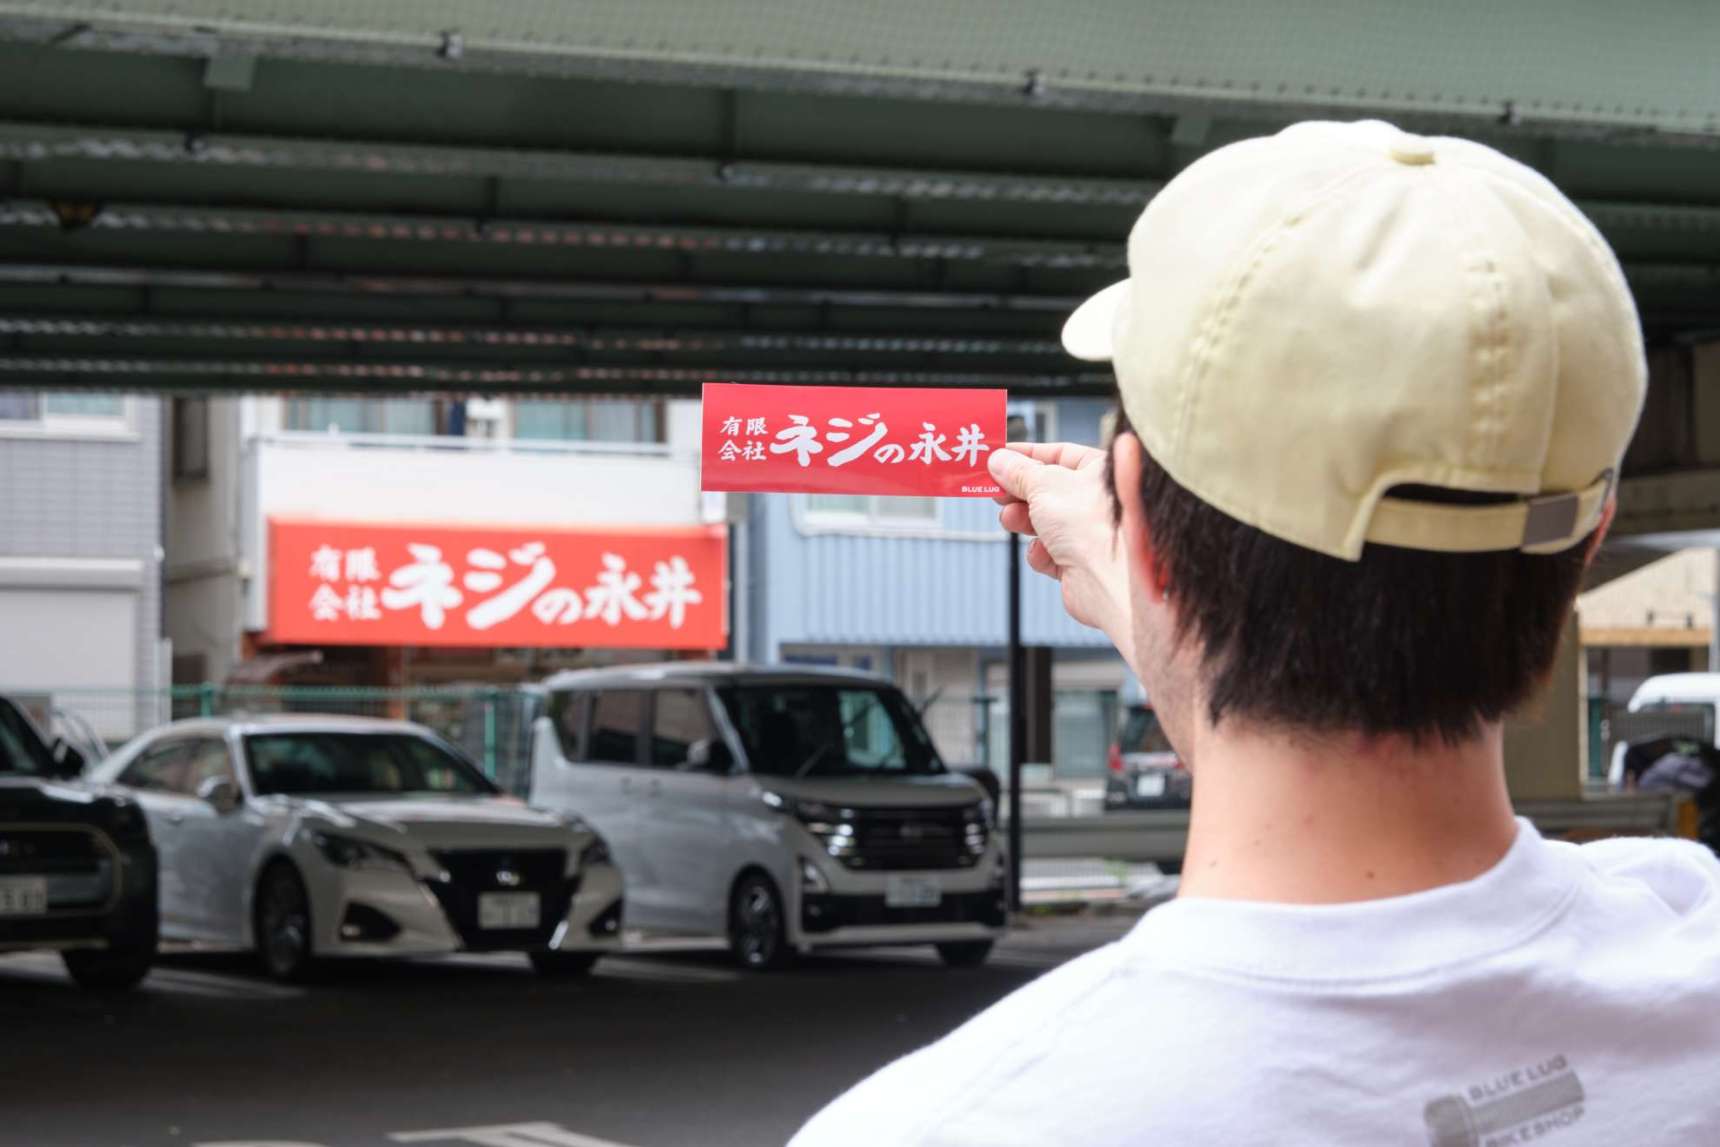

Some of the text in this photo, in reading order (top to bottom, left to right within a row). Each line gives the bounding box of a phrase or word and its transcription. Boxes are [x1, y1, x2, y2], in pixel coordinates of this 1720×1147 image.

[720, 416, 768, 436] 有限
[769, 412, 990, 467] ネジの永井
[718, 440, 767, 461] 会社
[309, 544, 382, 582] 有限
[309, 583, 382, 620] 会社
[381, 541, 702, 630] ネジの永井
